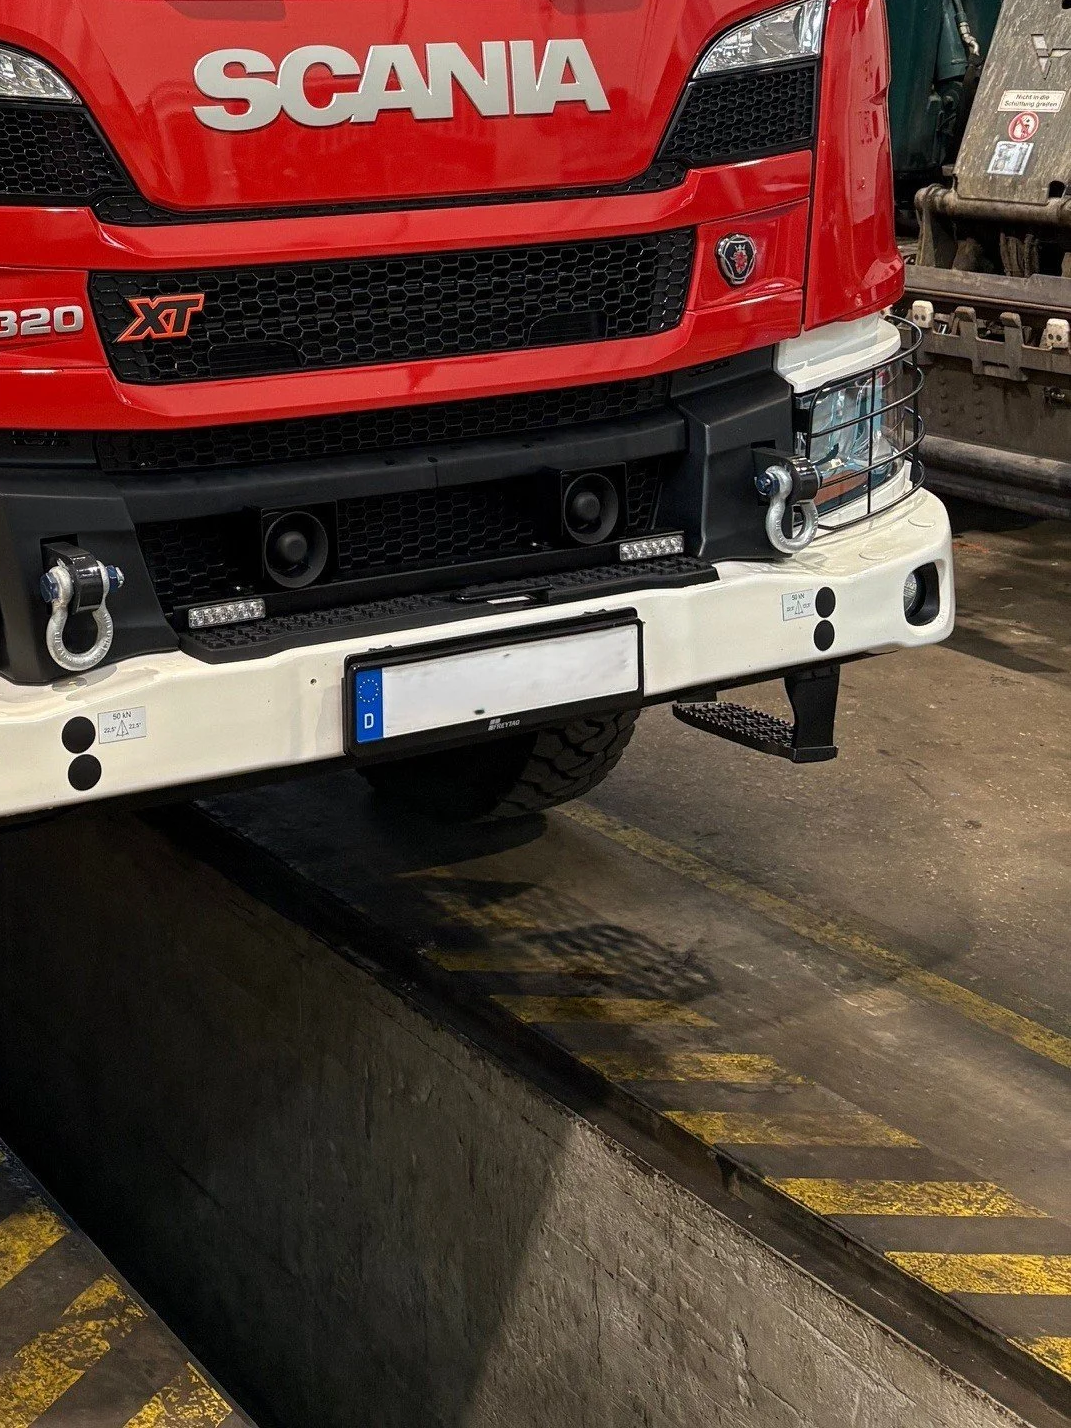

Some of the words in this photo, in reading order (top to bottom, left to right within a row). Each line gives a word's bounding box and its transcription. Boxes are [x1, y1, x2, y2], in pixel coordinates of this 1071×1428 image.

[193, 38, 611, 132] SCANIA
[113, 293, 205, 344] XT
[112, 712, 121, 720] 50
[122, 711, 132, 719] kN
[364, 713, 375, 729] D
